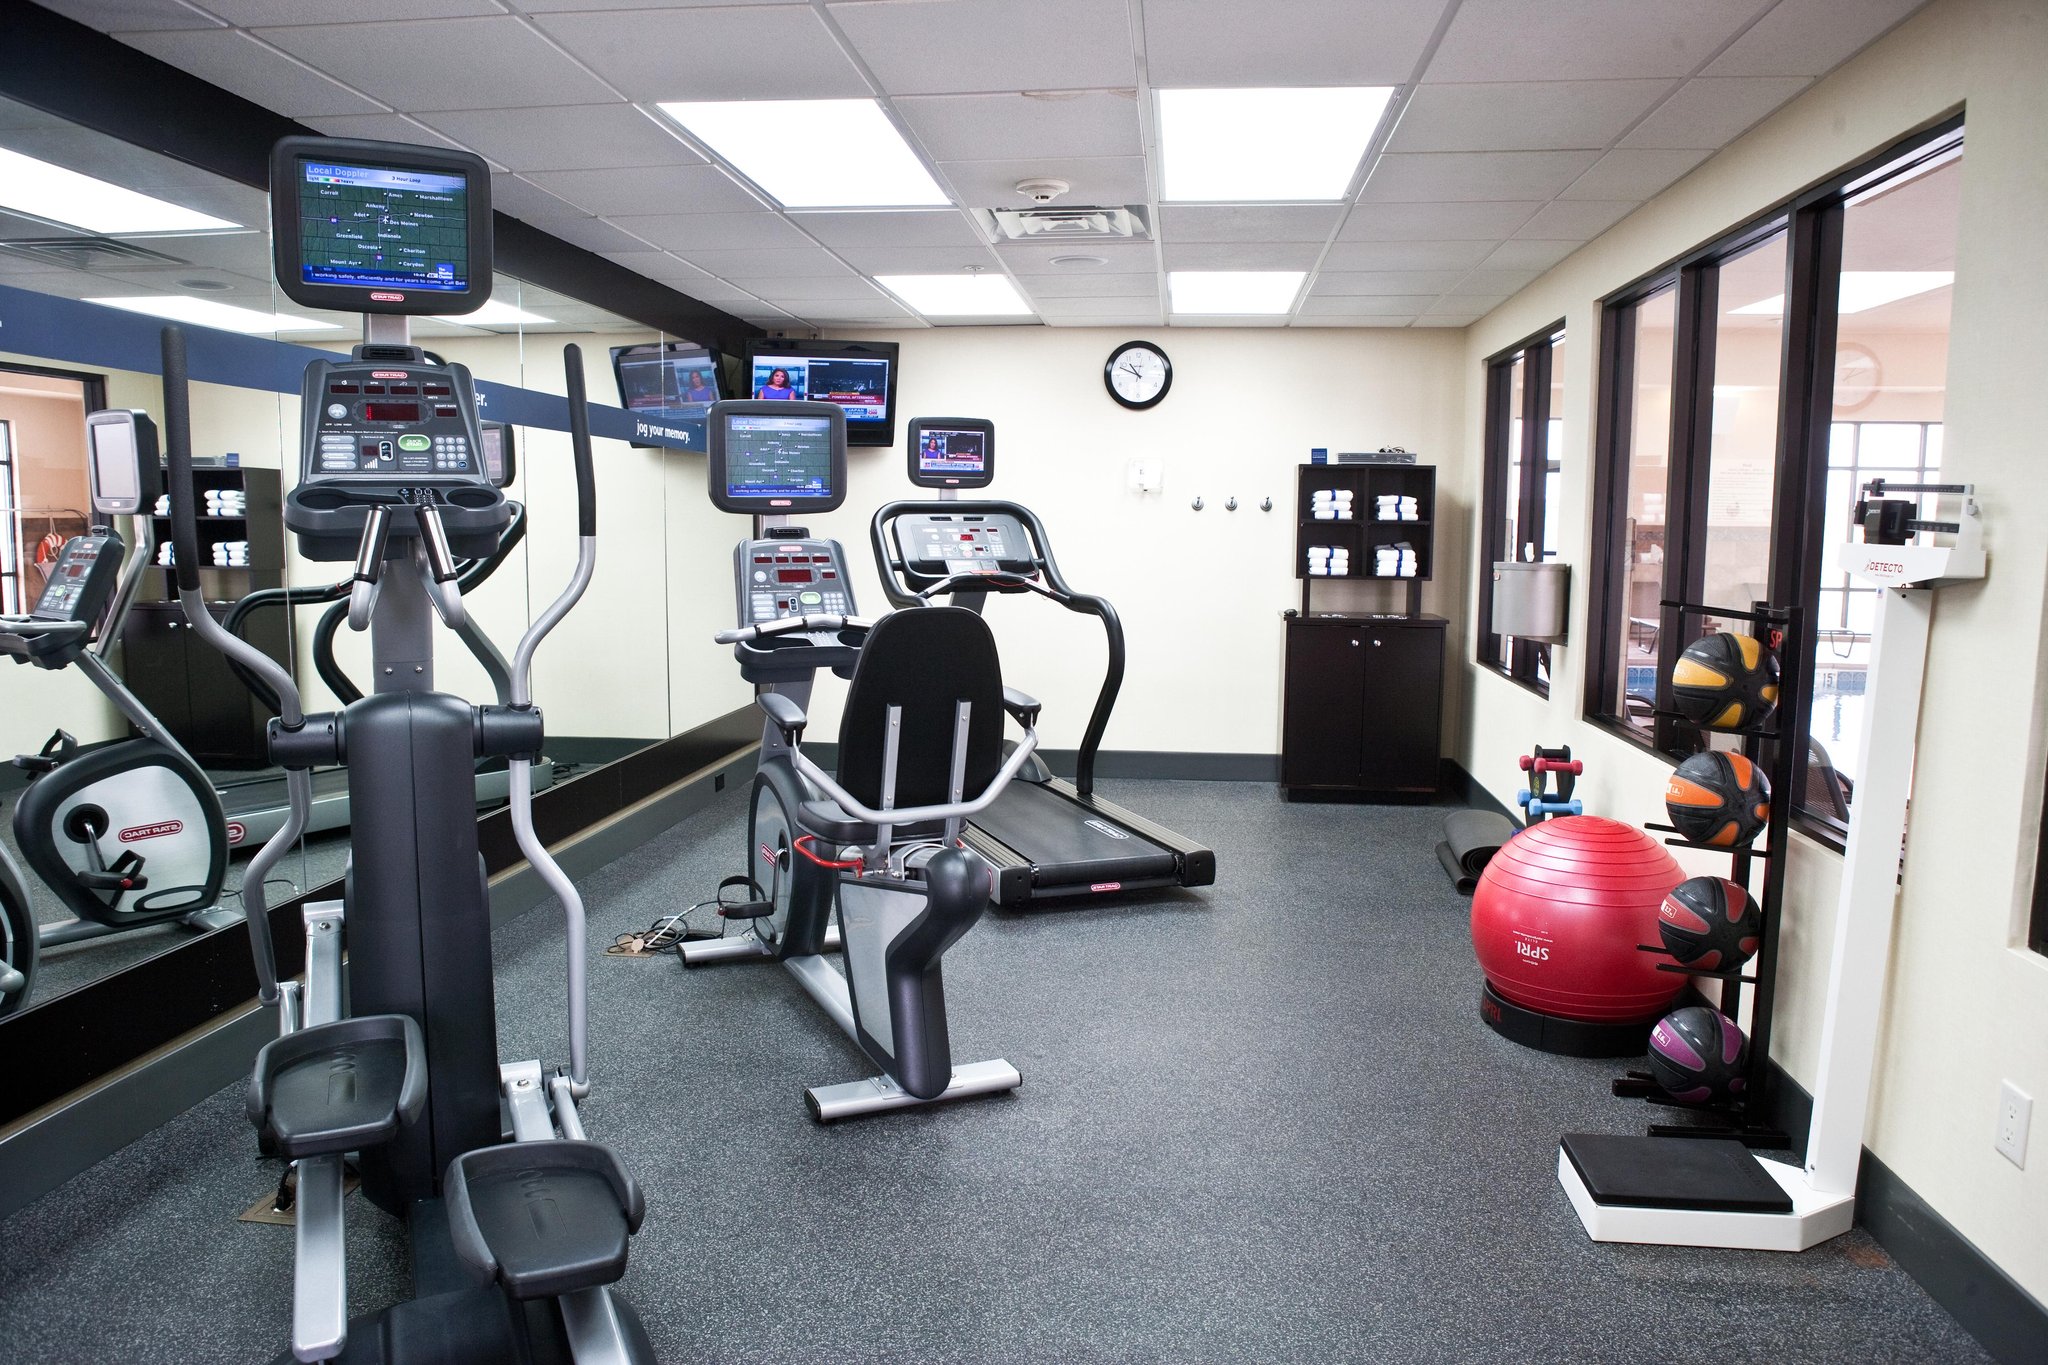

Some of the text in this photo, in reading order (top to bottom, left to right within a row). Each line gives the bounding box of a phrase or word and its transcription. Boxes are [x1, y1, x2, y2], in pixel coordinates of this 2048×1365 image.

[308, 165, 368, 178] Local Doppler
[335, 232, 363, 240] Greenfield
[315, 272, 338, 280] working
[357, 274, 383, 282] efficiently
[636, 419, 690, 444] jog your memory.
[1869, 561, 1904, 573] DETECTO
